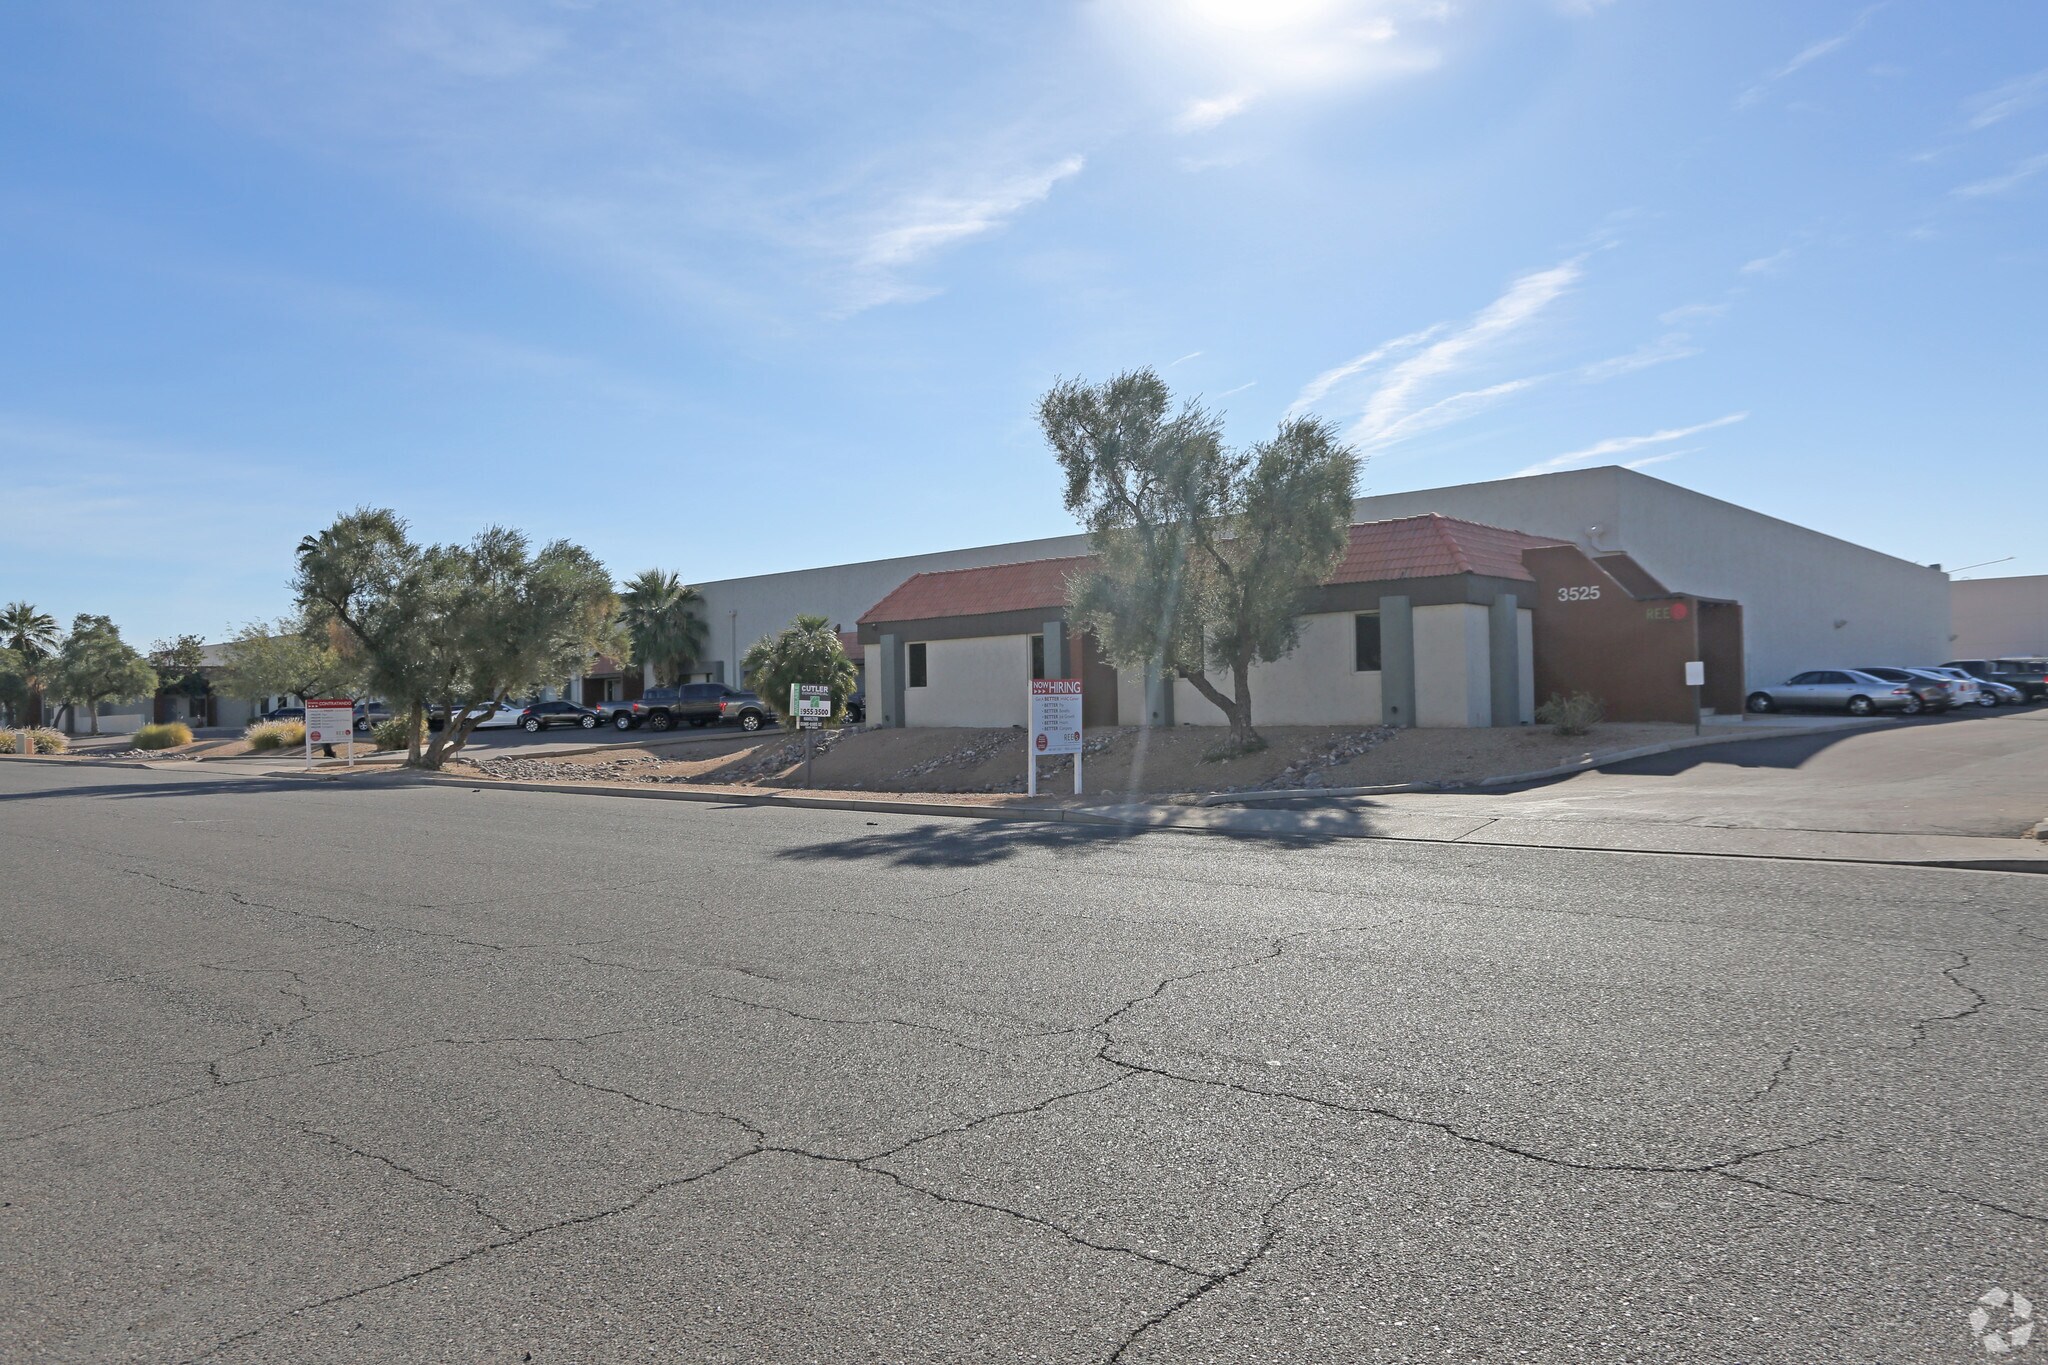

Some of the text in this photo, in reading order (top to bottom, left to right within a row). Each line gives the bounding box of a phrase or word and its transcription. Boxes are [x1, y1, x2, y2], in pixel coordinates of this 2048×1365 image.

[1558, 586, 1600, 601] 3525
[1033, 681, 1081, 694] NOW HIRING
